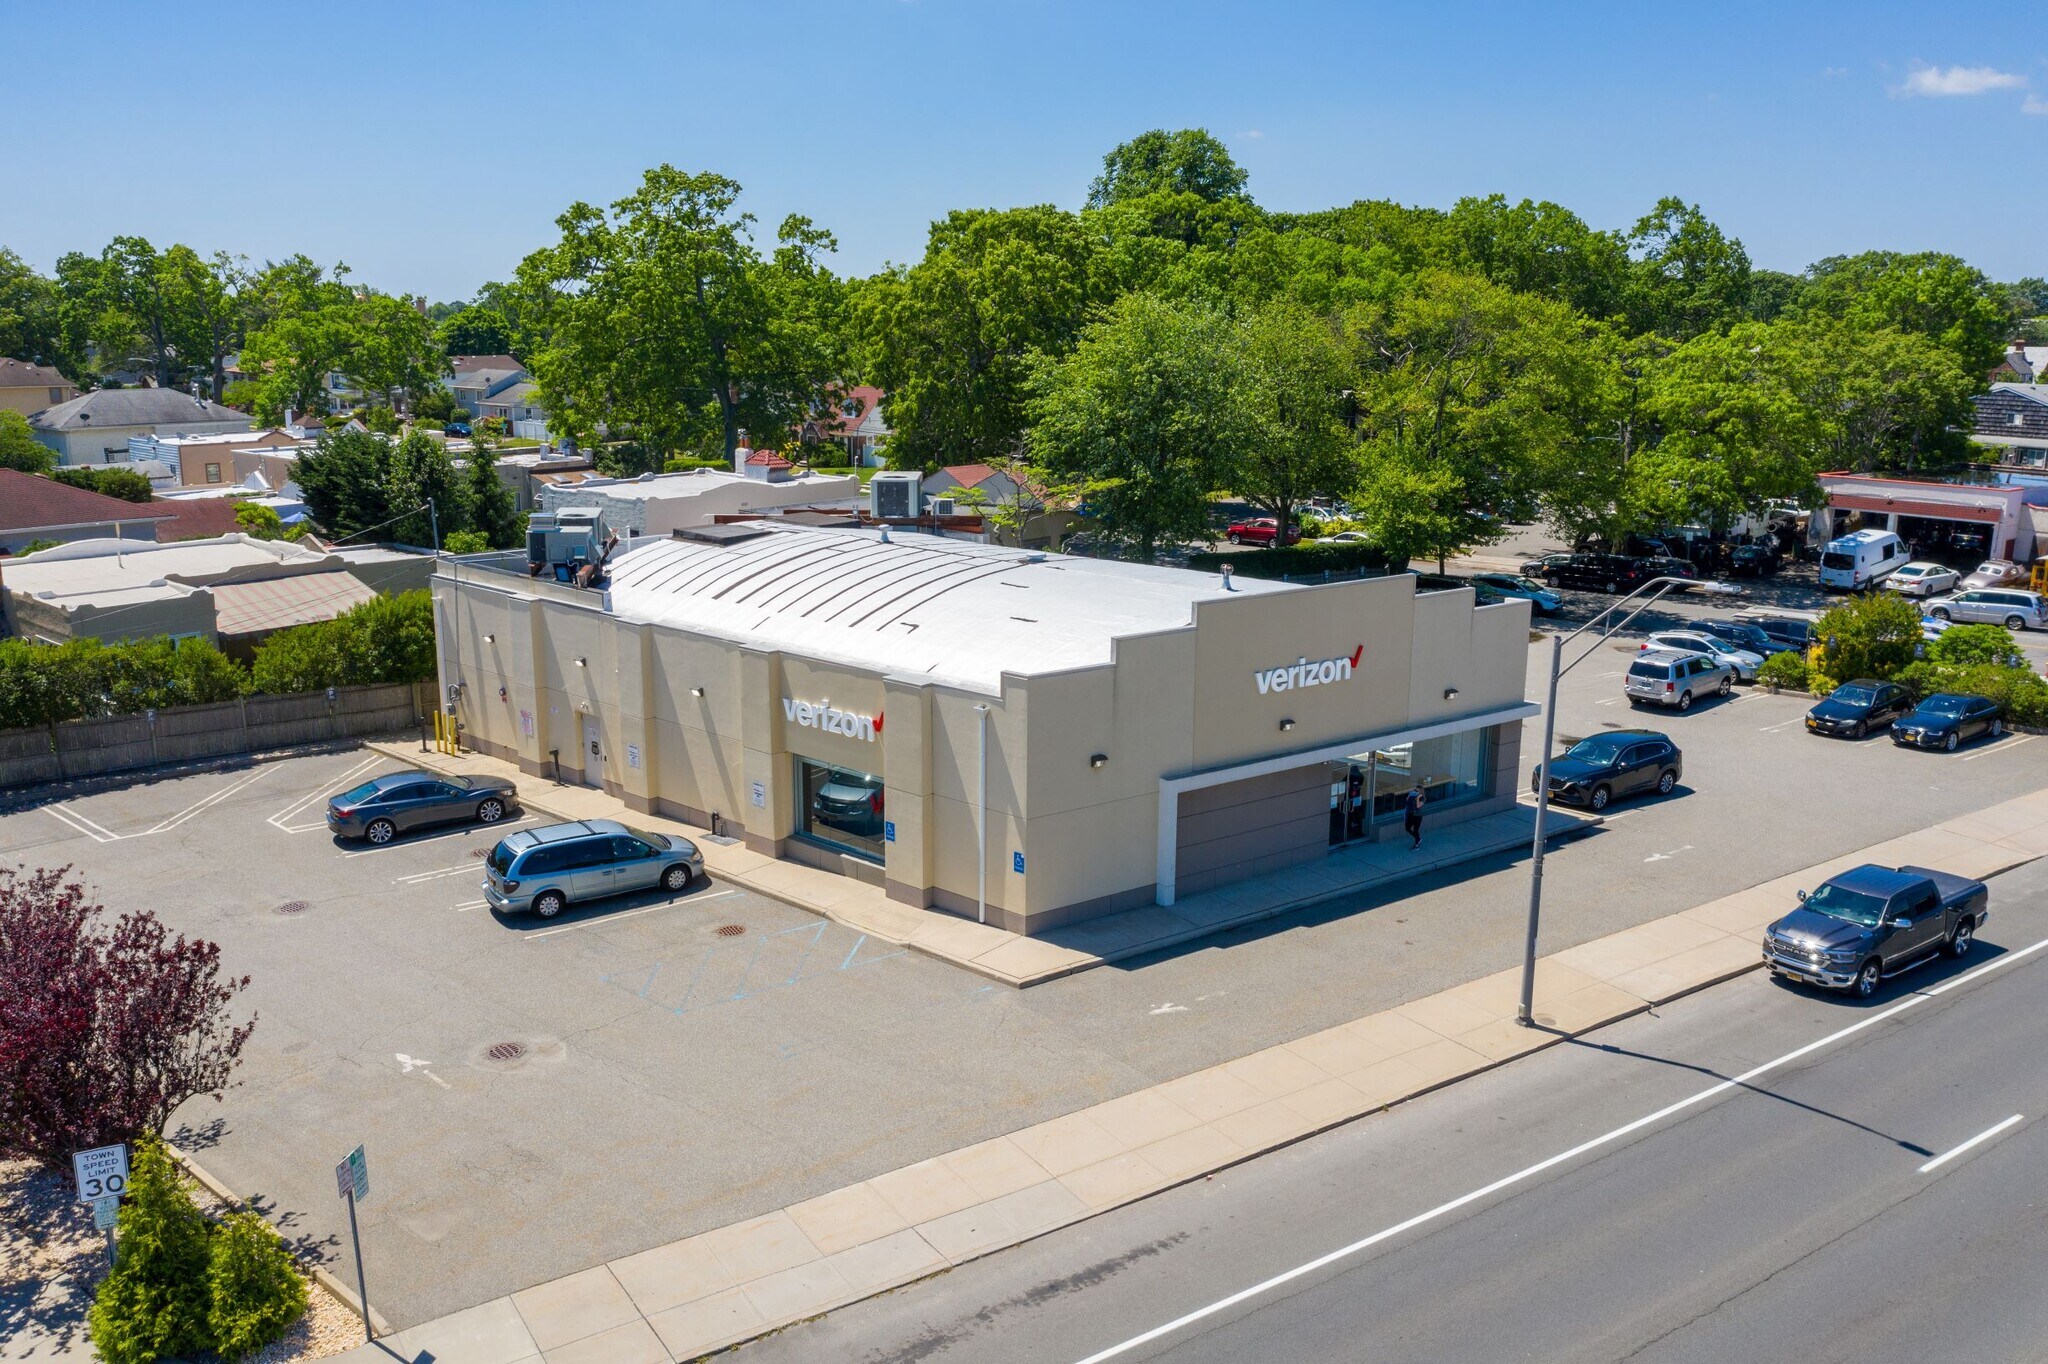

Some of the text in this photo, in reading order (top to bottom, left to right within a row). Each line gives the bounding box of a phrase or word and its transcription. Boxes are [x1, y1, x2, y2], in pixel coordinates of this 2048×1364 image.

[1255, 656, 1352, 695] verizon
[782, 698, 875, 742] verizon
[83, 1158, 118, 1170] SPEED
[85, 1151, 115, 1161] TOWN
[88, 1167, 115, 1178] LIMIT
[85, 1174, 124, 1197] 30
